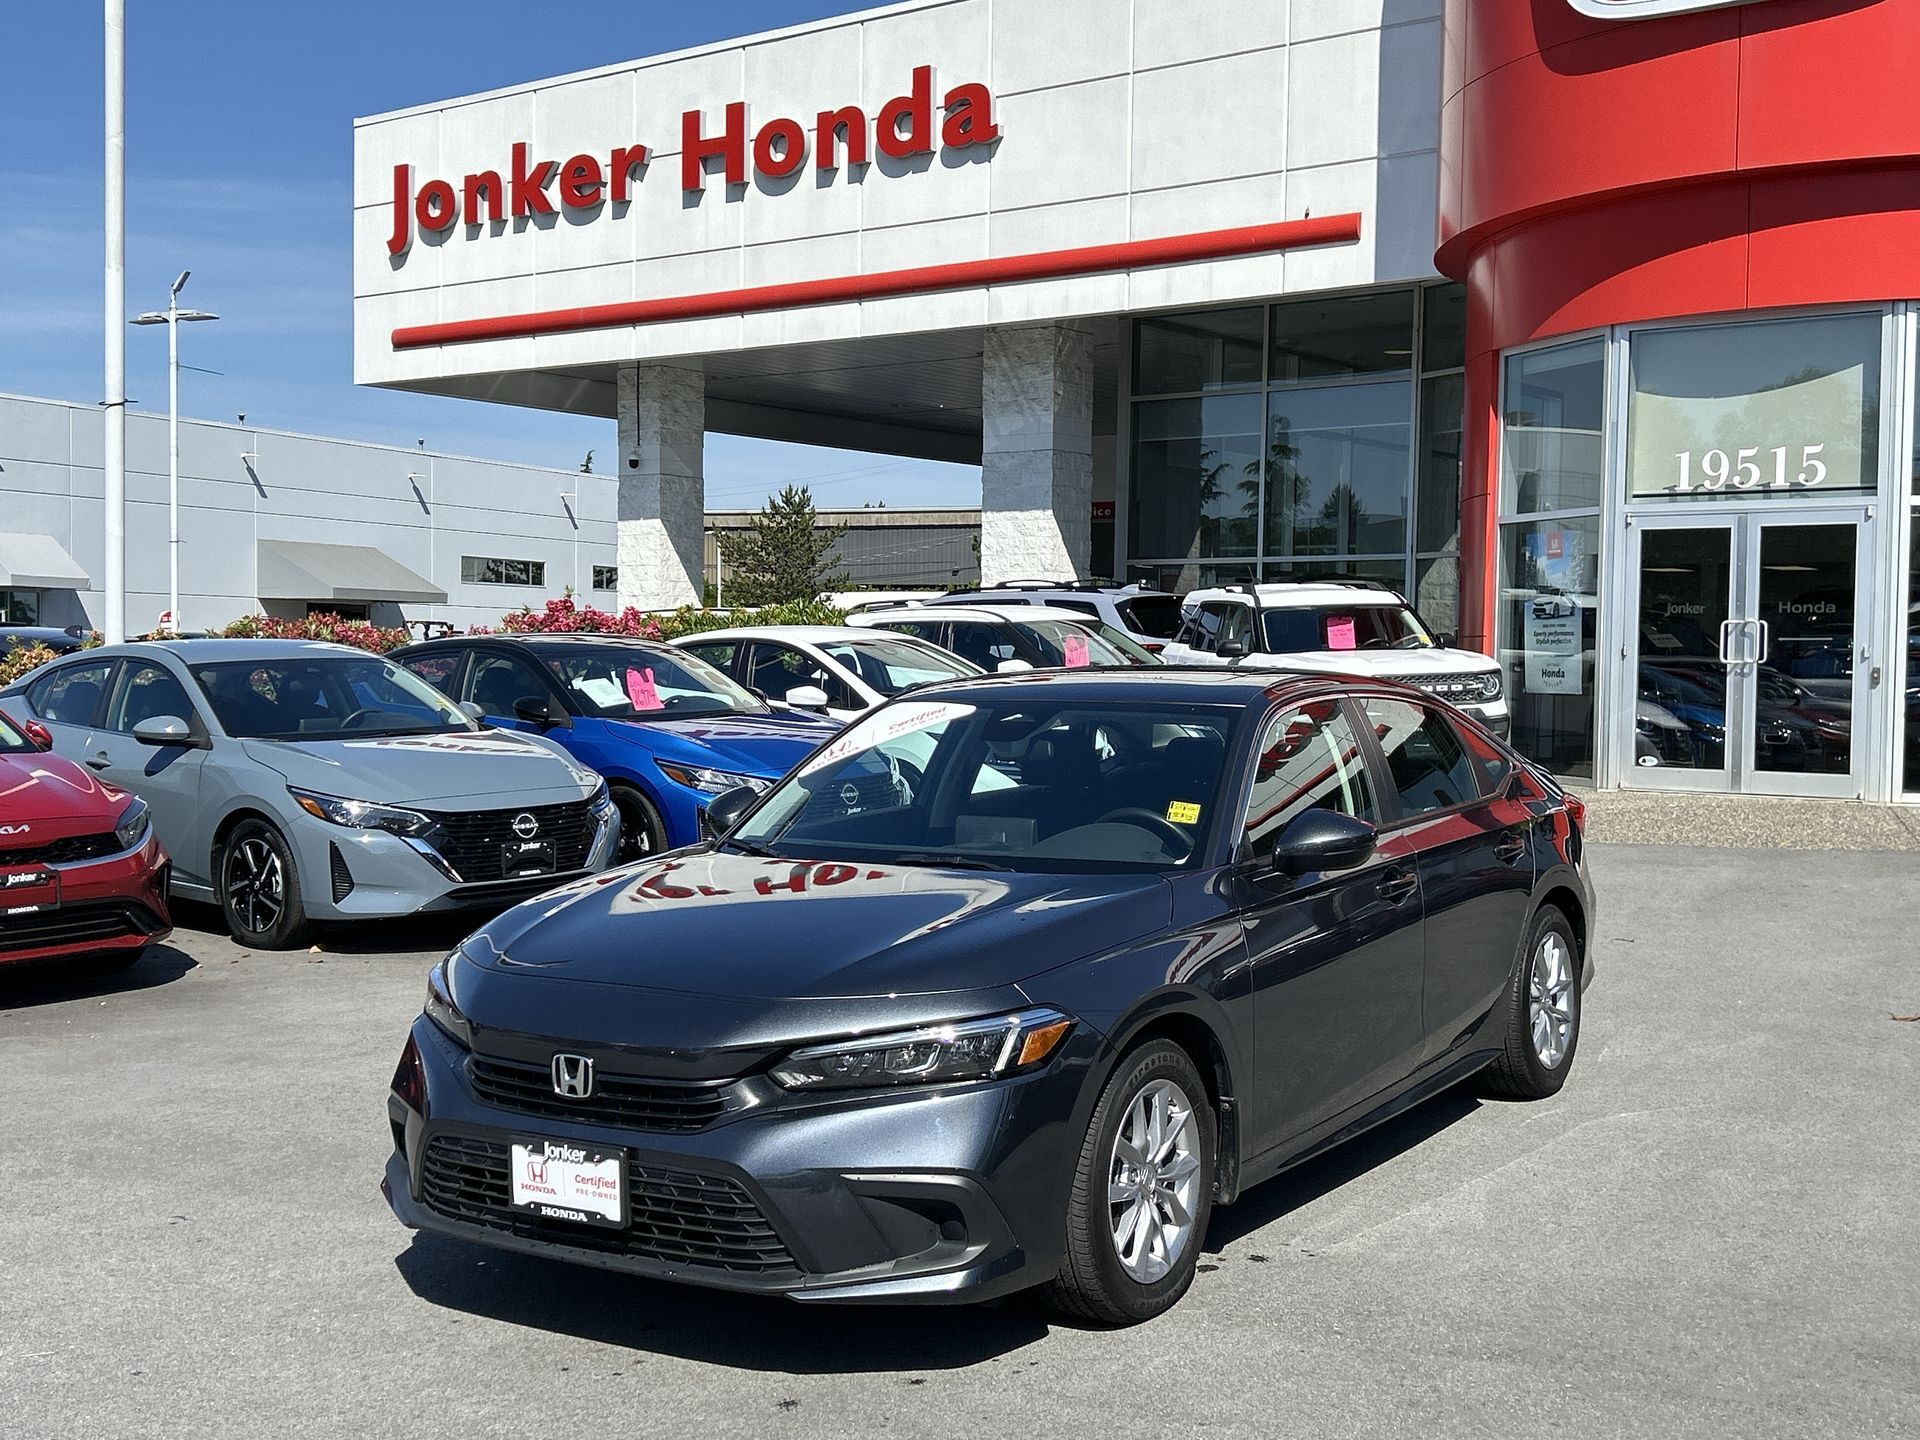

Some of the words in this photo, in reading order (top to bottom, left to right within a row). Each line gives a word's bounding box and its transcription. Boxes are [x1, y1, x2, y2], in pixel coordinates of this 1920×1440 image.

[386, 142, 652, 256] Jonker
[682, 65, 1002, 194] Honda
[1673, 442, 1828, 491] 19515
[1666, 601, 1706, 616] Jonker
[1778, 601, 1836, 615] Honda
[1541, 668, 1565, 678] Honda
[512, 822, 539, 830] NISSAN
[6, 873, 37, 886] Jonker
[543, 1141, 587, 1163] Jonker
[574, 1174, 616, 1190] Certified
[520, 1183, 558, 1196] HONDA
[575, 1187, 618, 1201] PRE-OWNED
[540, 1206, 588, 1222] HONDA
